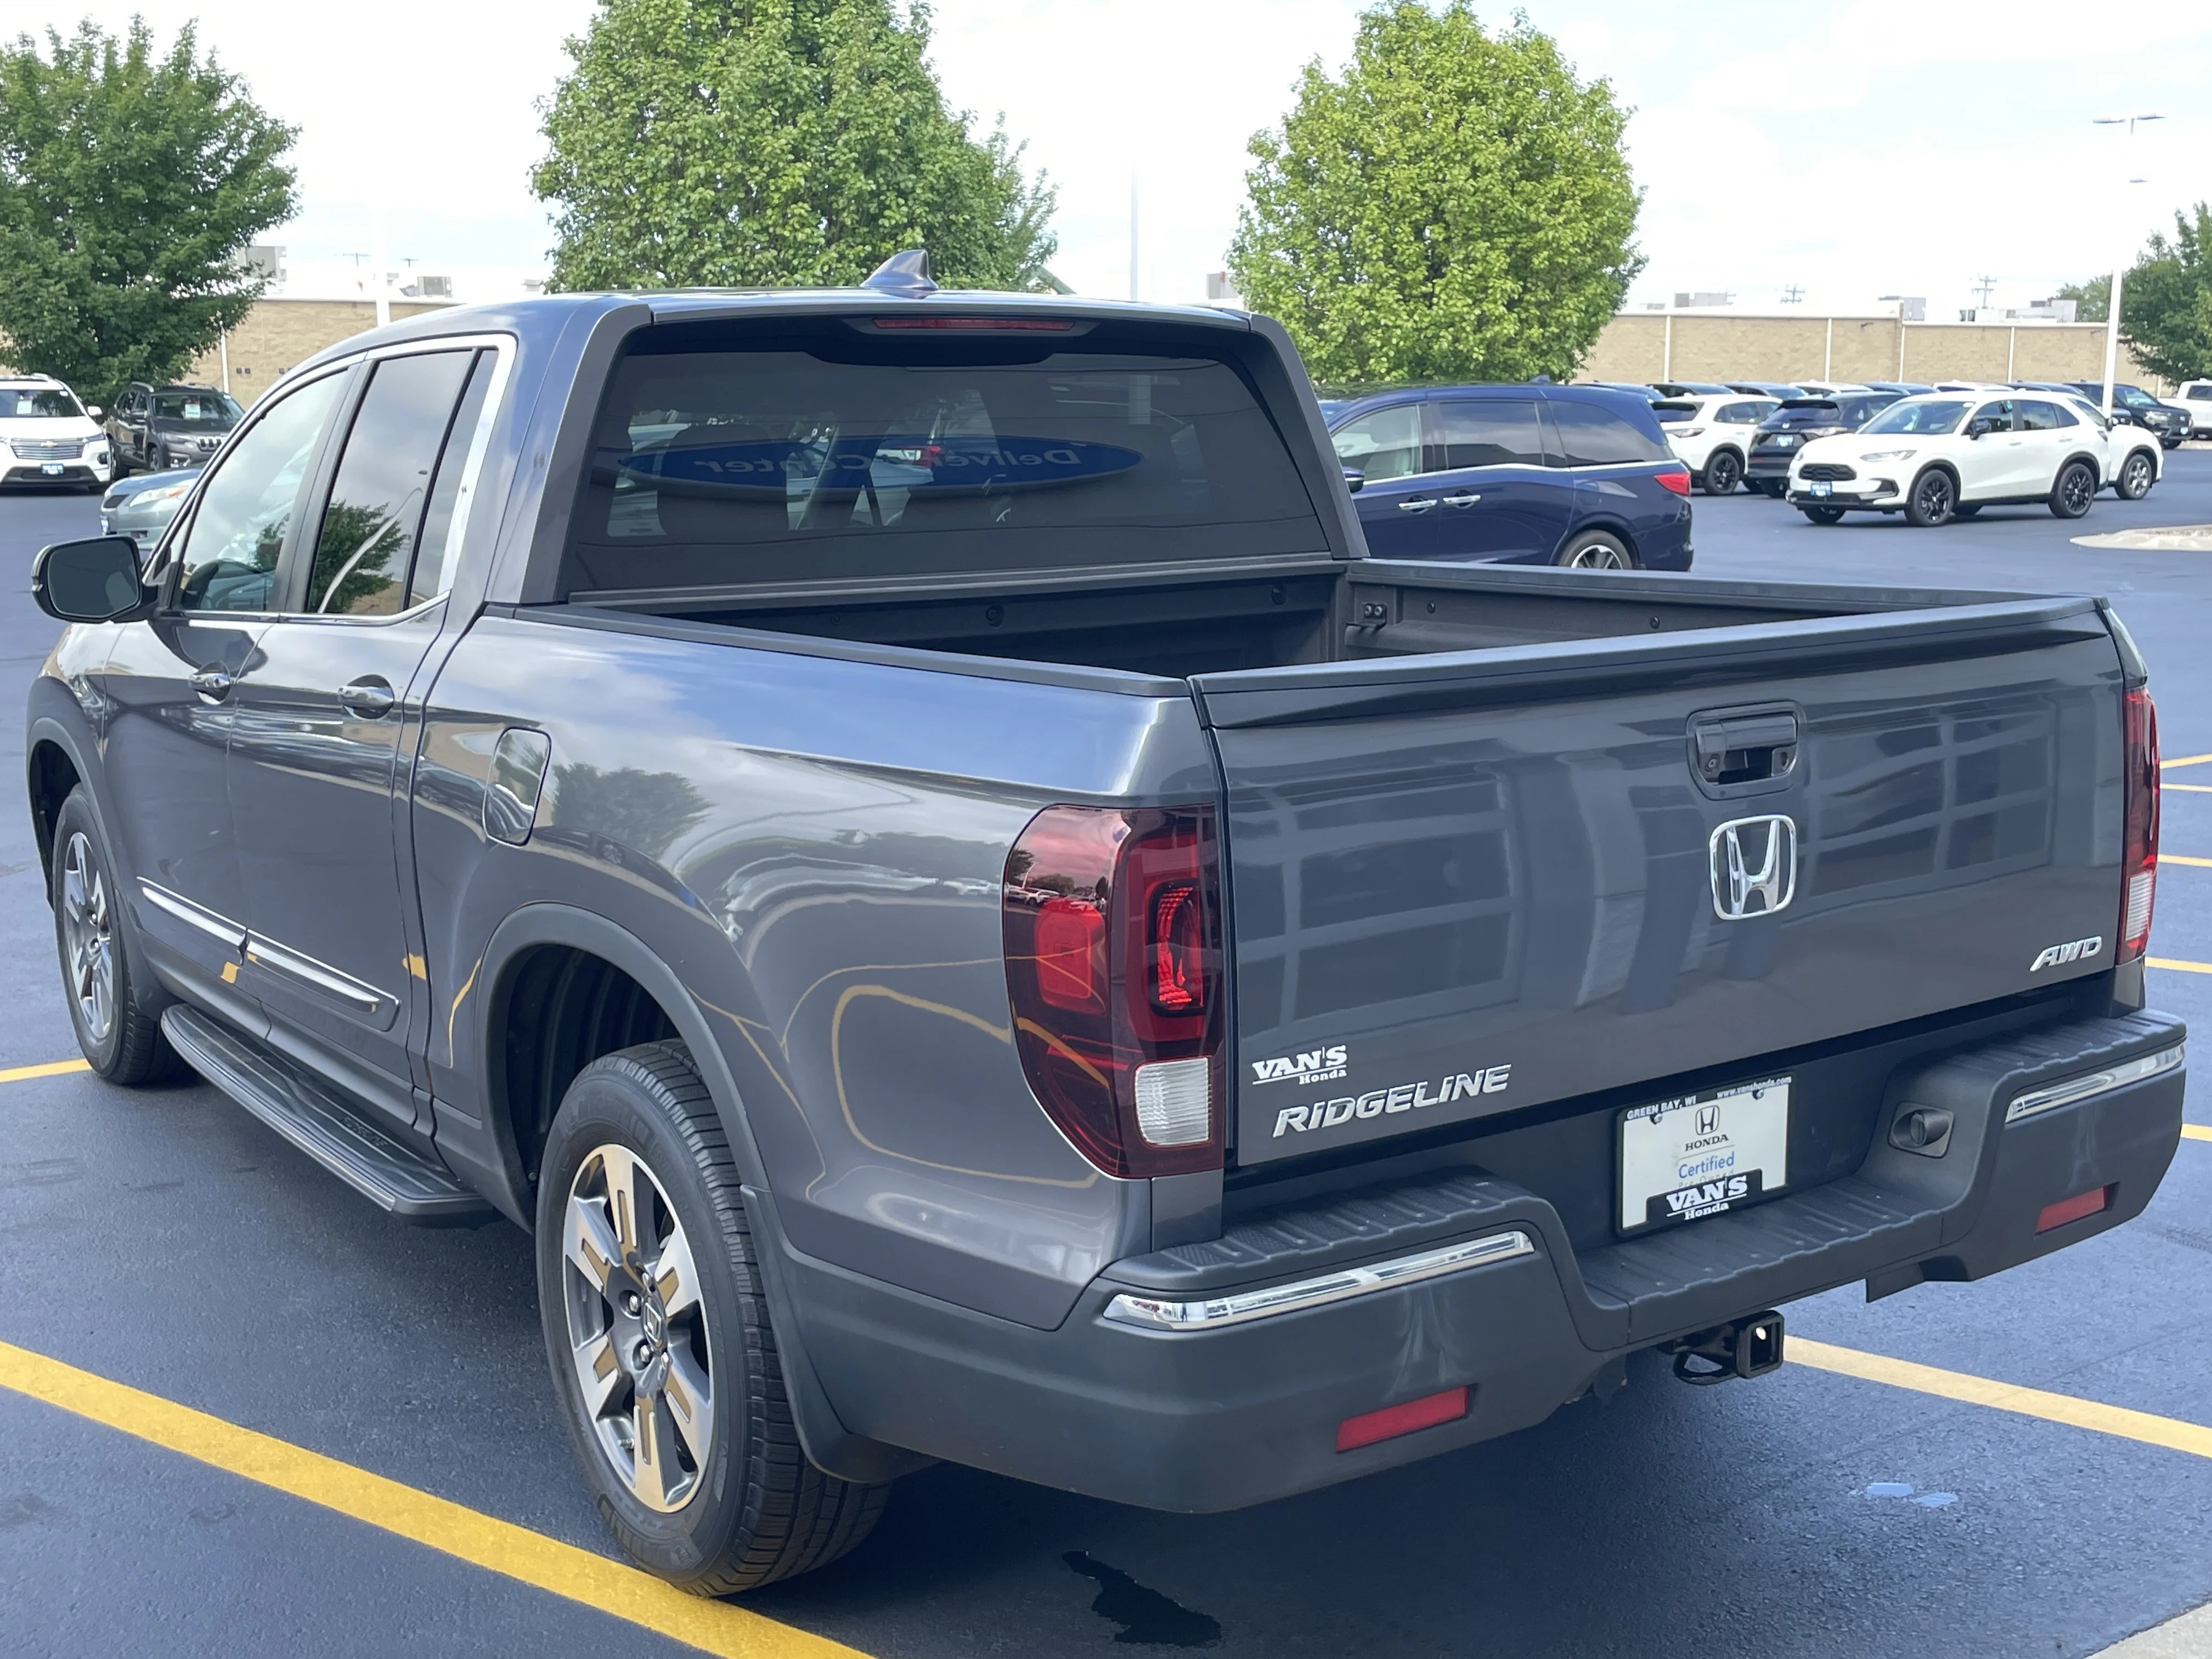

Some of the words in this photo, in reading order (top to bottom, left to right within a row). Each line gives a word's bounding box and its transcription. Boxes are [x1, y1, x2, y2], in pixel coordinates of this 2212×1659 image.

[2029, 936, 2102, 972] AWD
[1251, 1045, 1347, 1079] VAN'S
[1299, 1069, 1347, 1085] Honda
[1273, 1064, 1511, 1138] RIDGELINE
[1627, 1104, 1659, 1120] GREEN
[1661, 1099, 1682, 1112] BAY,
[1685, 1095, 1696, 1106] WI
[1685, 1134, 1729, 1152] HONDA
[1679, 1151, 1735, 1179] Certified
[1666, 1175, 1747, 1211] VAN'S
[1684, 1202, 1729, 1220] Honda
